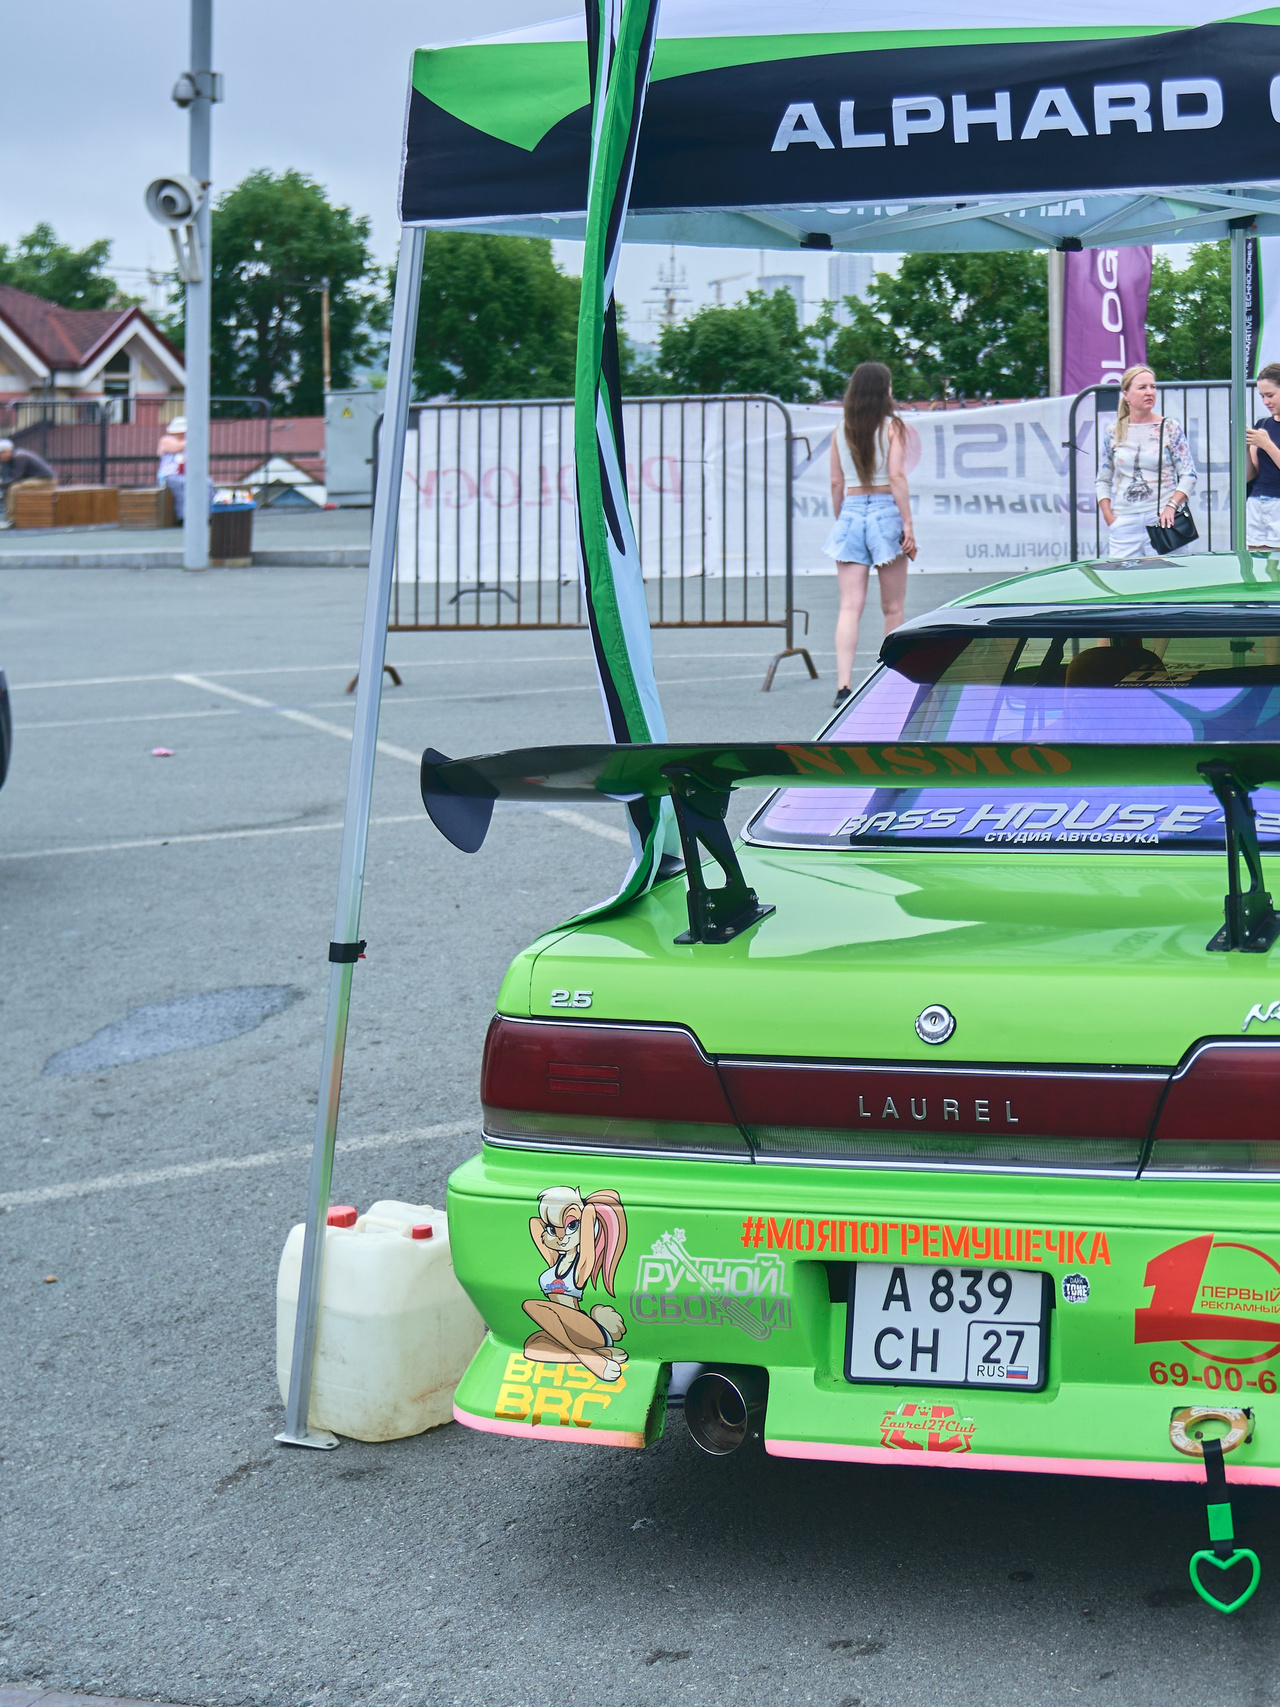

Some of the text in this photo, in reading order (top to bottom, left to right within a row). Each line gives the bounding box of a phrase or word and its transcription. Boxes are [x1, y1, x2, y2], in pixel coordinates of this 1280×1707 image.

[770, 79, 1224, 152] ALPHARD
[776, 745, 1072, 776] NISMO
[829, 807, 965, 837] BASS
[959, 799, 1220, 835] HOUSE
[984, 831, 1160, 845] СТУДИЯ АВТОЗВУКА
[550, 989, 593, 1008] 2.5
[858, 1095, 1019, 1122] LAUREL
[741, 1216, 1112, 1266] #МОЯПОГРЕМУШЕЧКА
[641, 1259, 781, 1297] РУЧНОЙ
[882, 1267, 1013, 1315] А 839
[1066, 1284, 1088, 1297] TONE
[874, 1326, 940, 1373] СН
[982, 1329, 1025, 1365] 27
[976, 1364, 1005, 1379] RUS
[494, 1383, 613, 1428] BRC
[880, 1416, 978, 1433] Laurel27Club
